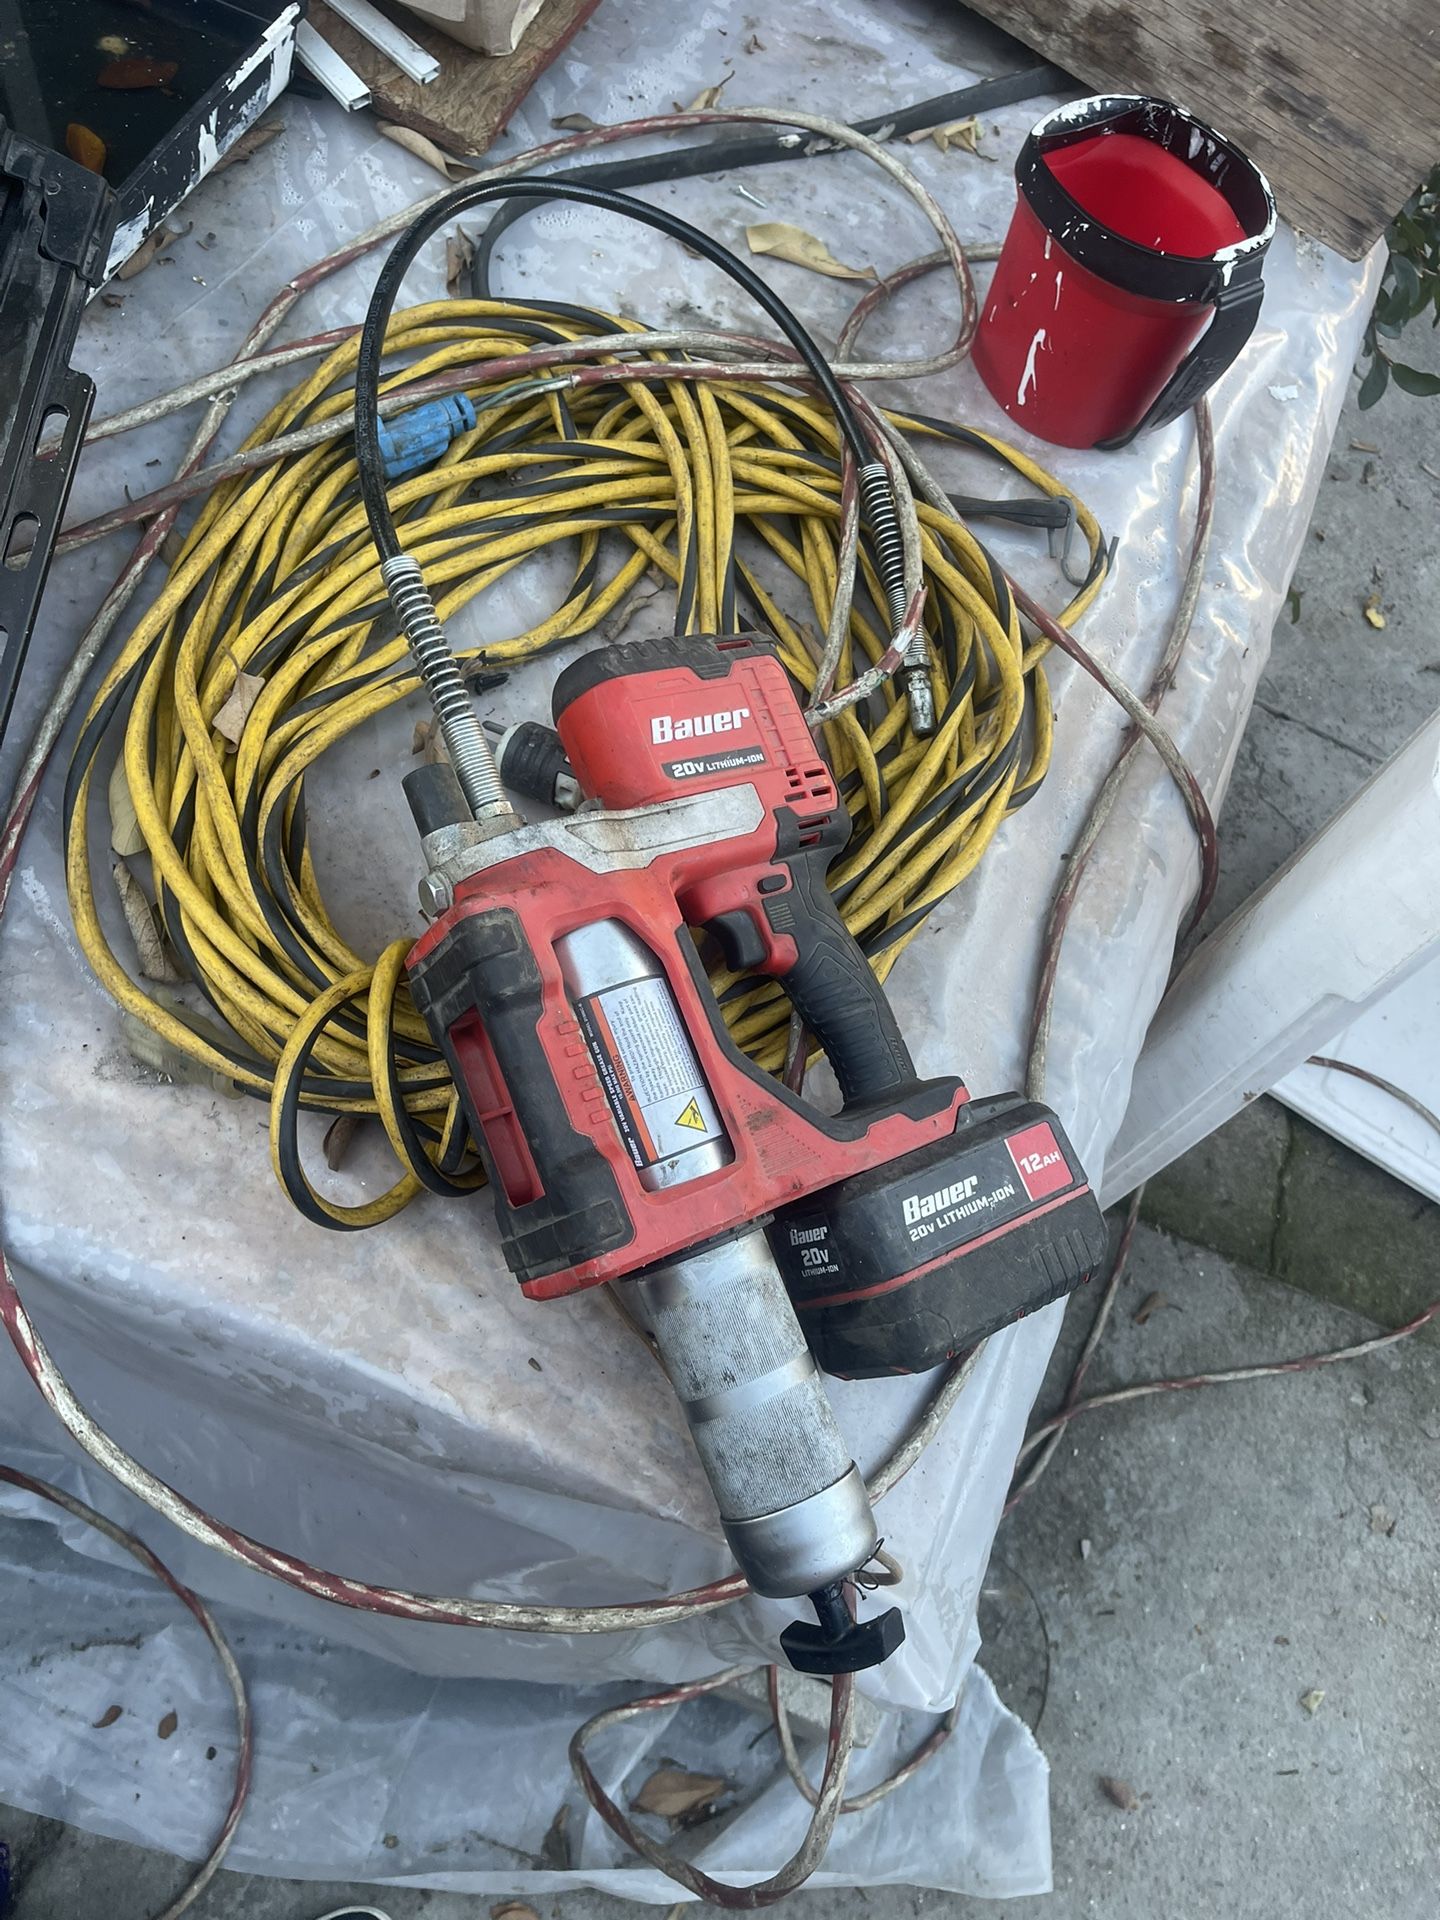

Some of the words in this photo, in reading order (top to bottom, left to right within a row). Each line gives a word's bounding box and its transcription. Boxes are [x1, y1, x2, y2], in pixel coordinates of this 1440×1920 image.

[651, 708, 750, 745] Bauer
[706, 753, 764, 771] LITHIUM-ION
[591, 1040, 600, 1053] GUN
[596, 1054, 608, 1075] GREASE
[606, 1063, 614, 1073] PSI
[611, 1053, 634, 1096] WARNING
[604, 1075, 615, 1094] SPEED
[610, 1072, 618, 1084] MAX
[637, 1073, 652, 1103] INJECTION
[610, 1093, 626, 1121] VARIABLE
[627, 1137, 643, 1167] Bauer
[902, 1175, 978, 1226] Bauer
[938, 1183, 1015, 1230] LITHIUM-ION
[790, 1225, 828, 1246] Bauer
[801, 1264, 839, 1278] LITHIUM-ION
